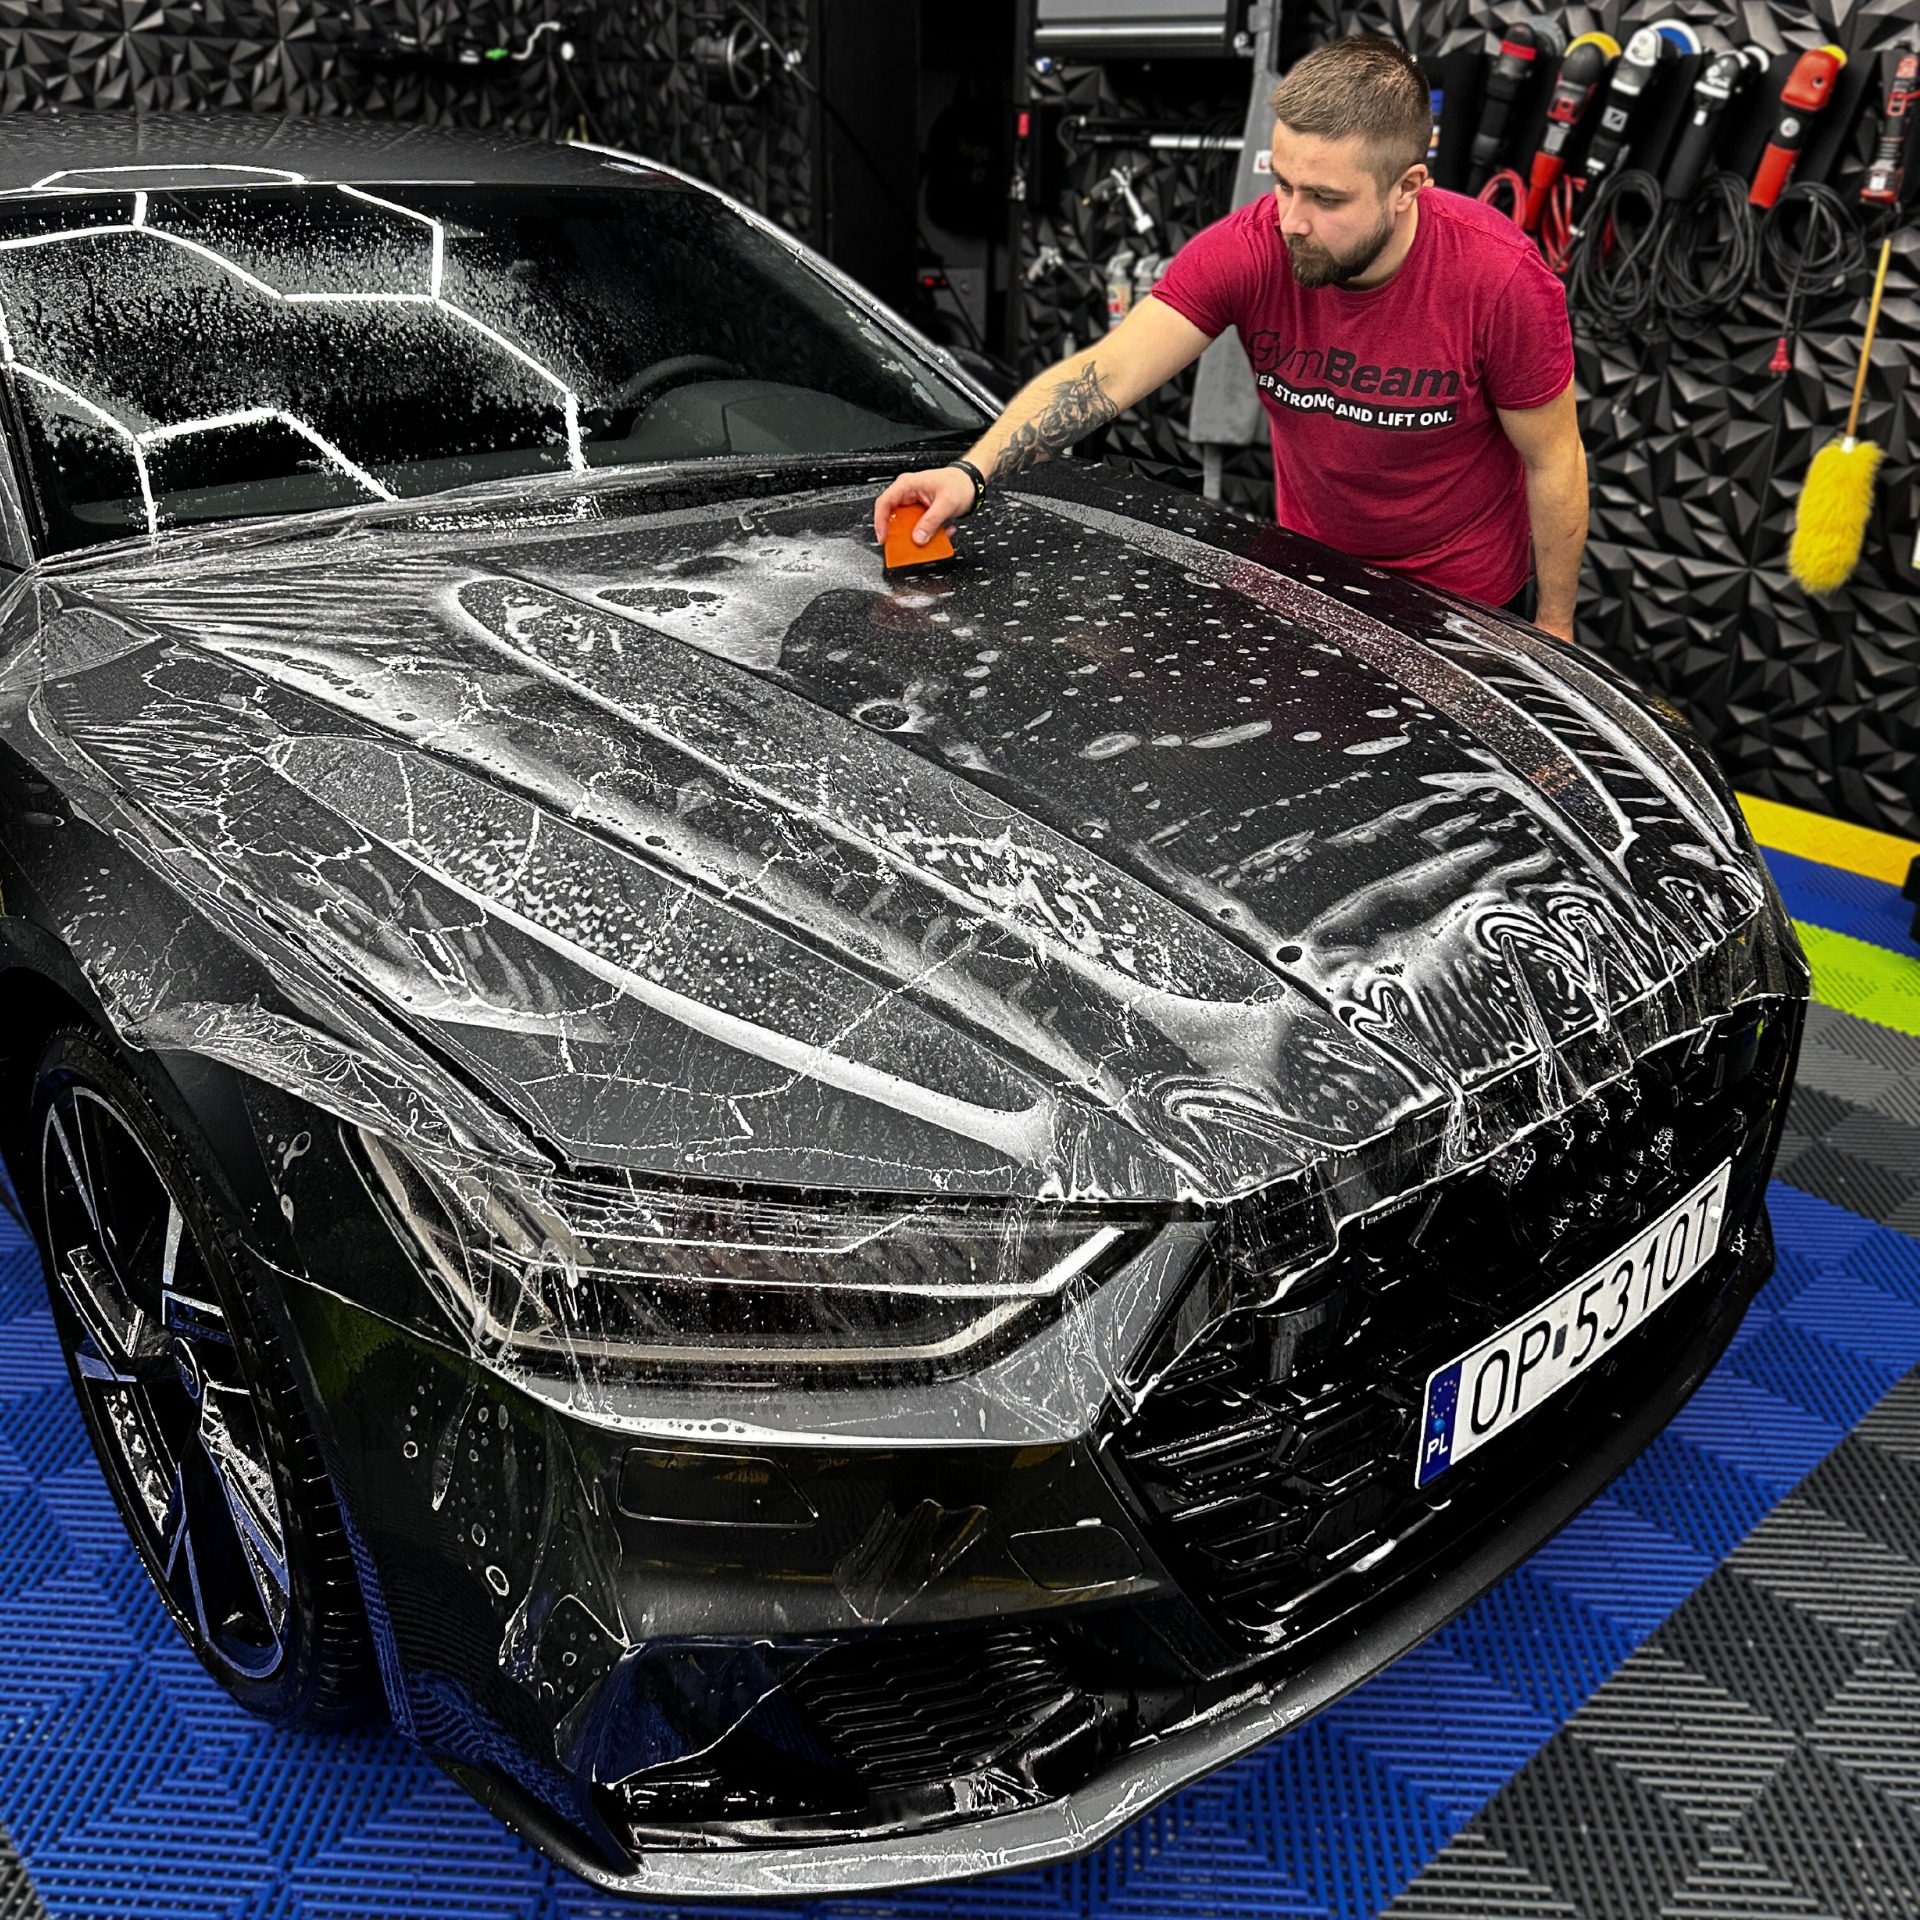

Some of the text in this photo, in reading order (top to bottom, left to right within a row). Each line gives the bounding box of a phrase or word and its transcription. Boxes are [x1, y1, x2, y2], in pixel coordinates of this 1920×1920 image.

[1248, 329, 1459, 397] GymBeam
[1274, 383, 1335, 411] STRONG
[1335, 403, 1373, 422] AND
[1378, 411, 1415, 427] LIFT
[1420, 410, 1453, 426] ON.
[1366, 1196, 1418, 1225] quattro
[1471, 1319, 1551, 1435] OP
[1426, 1432, 1449, 1464] PL
